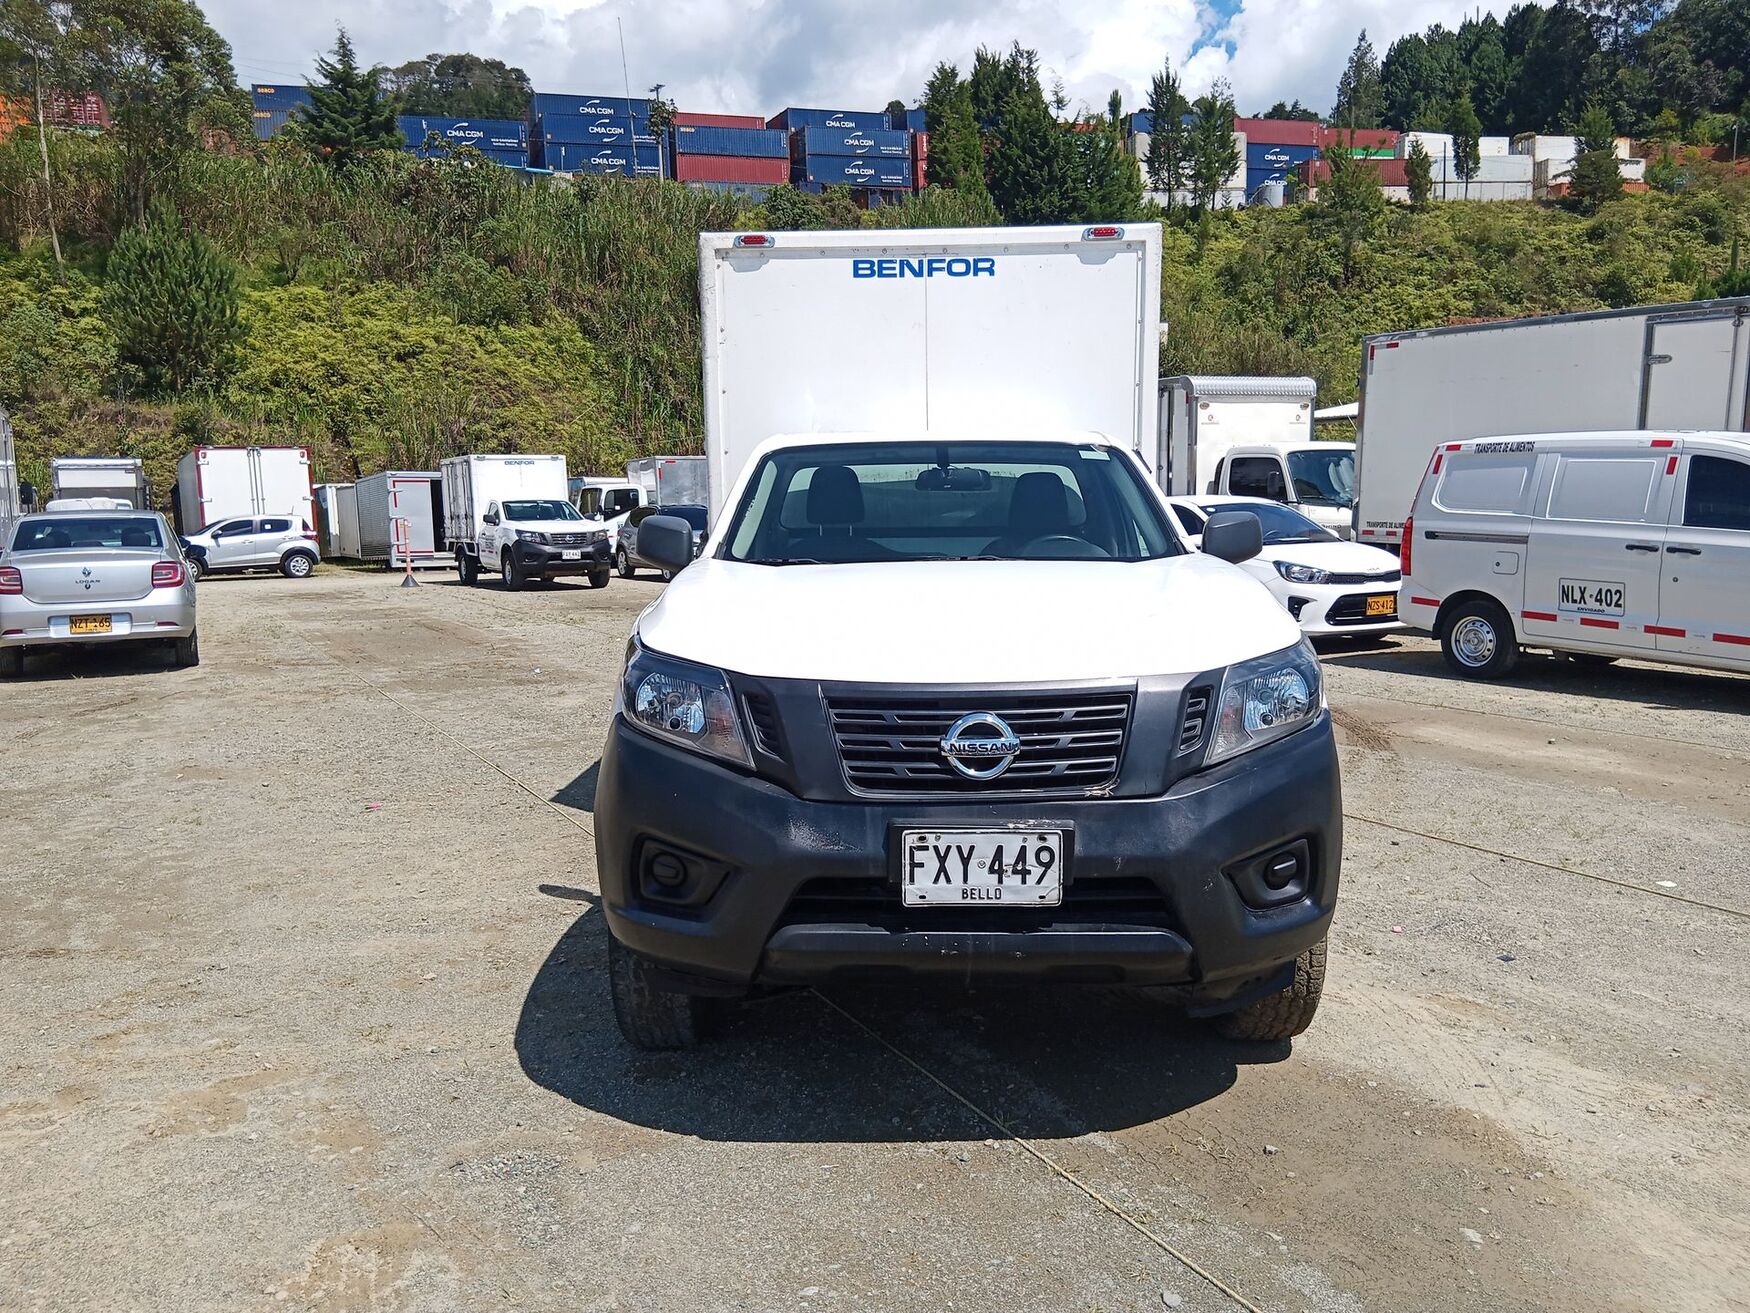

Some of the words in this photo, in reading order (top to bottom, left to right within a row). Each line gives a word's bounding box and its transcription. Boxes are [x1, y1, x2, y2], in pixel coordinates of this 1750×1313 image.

[579, 106, 596, 114] CMA
[596, 107, 614, 115] CGM
[446, 129, 465, 137] CMA
[588, 126, 606, 134] CMA
[606, 127, 624, 135] CGM
[590, 157, 608, 165] CMA
[859, 168, 875, 176] CGM
[852, 257, 996, 279] BENFOR
[1474, 443, 1503, 454] TRANSPORTE
[1502, 442, 1511, 453] DE
[1561, 584, 1587, 605] NLX
[1594, 587, 1622, 608] 402
[948, 742, 1012, 753] NISSAN
[908, 844, 976, 885] FXY
[988, 844, 1056, 885] 449
[961, 887, 1002, 900] BELLO
